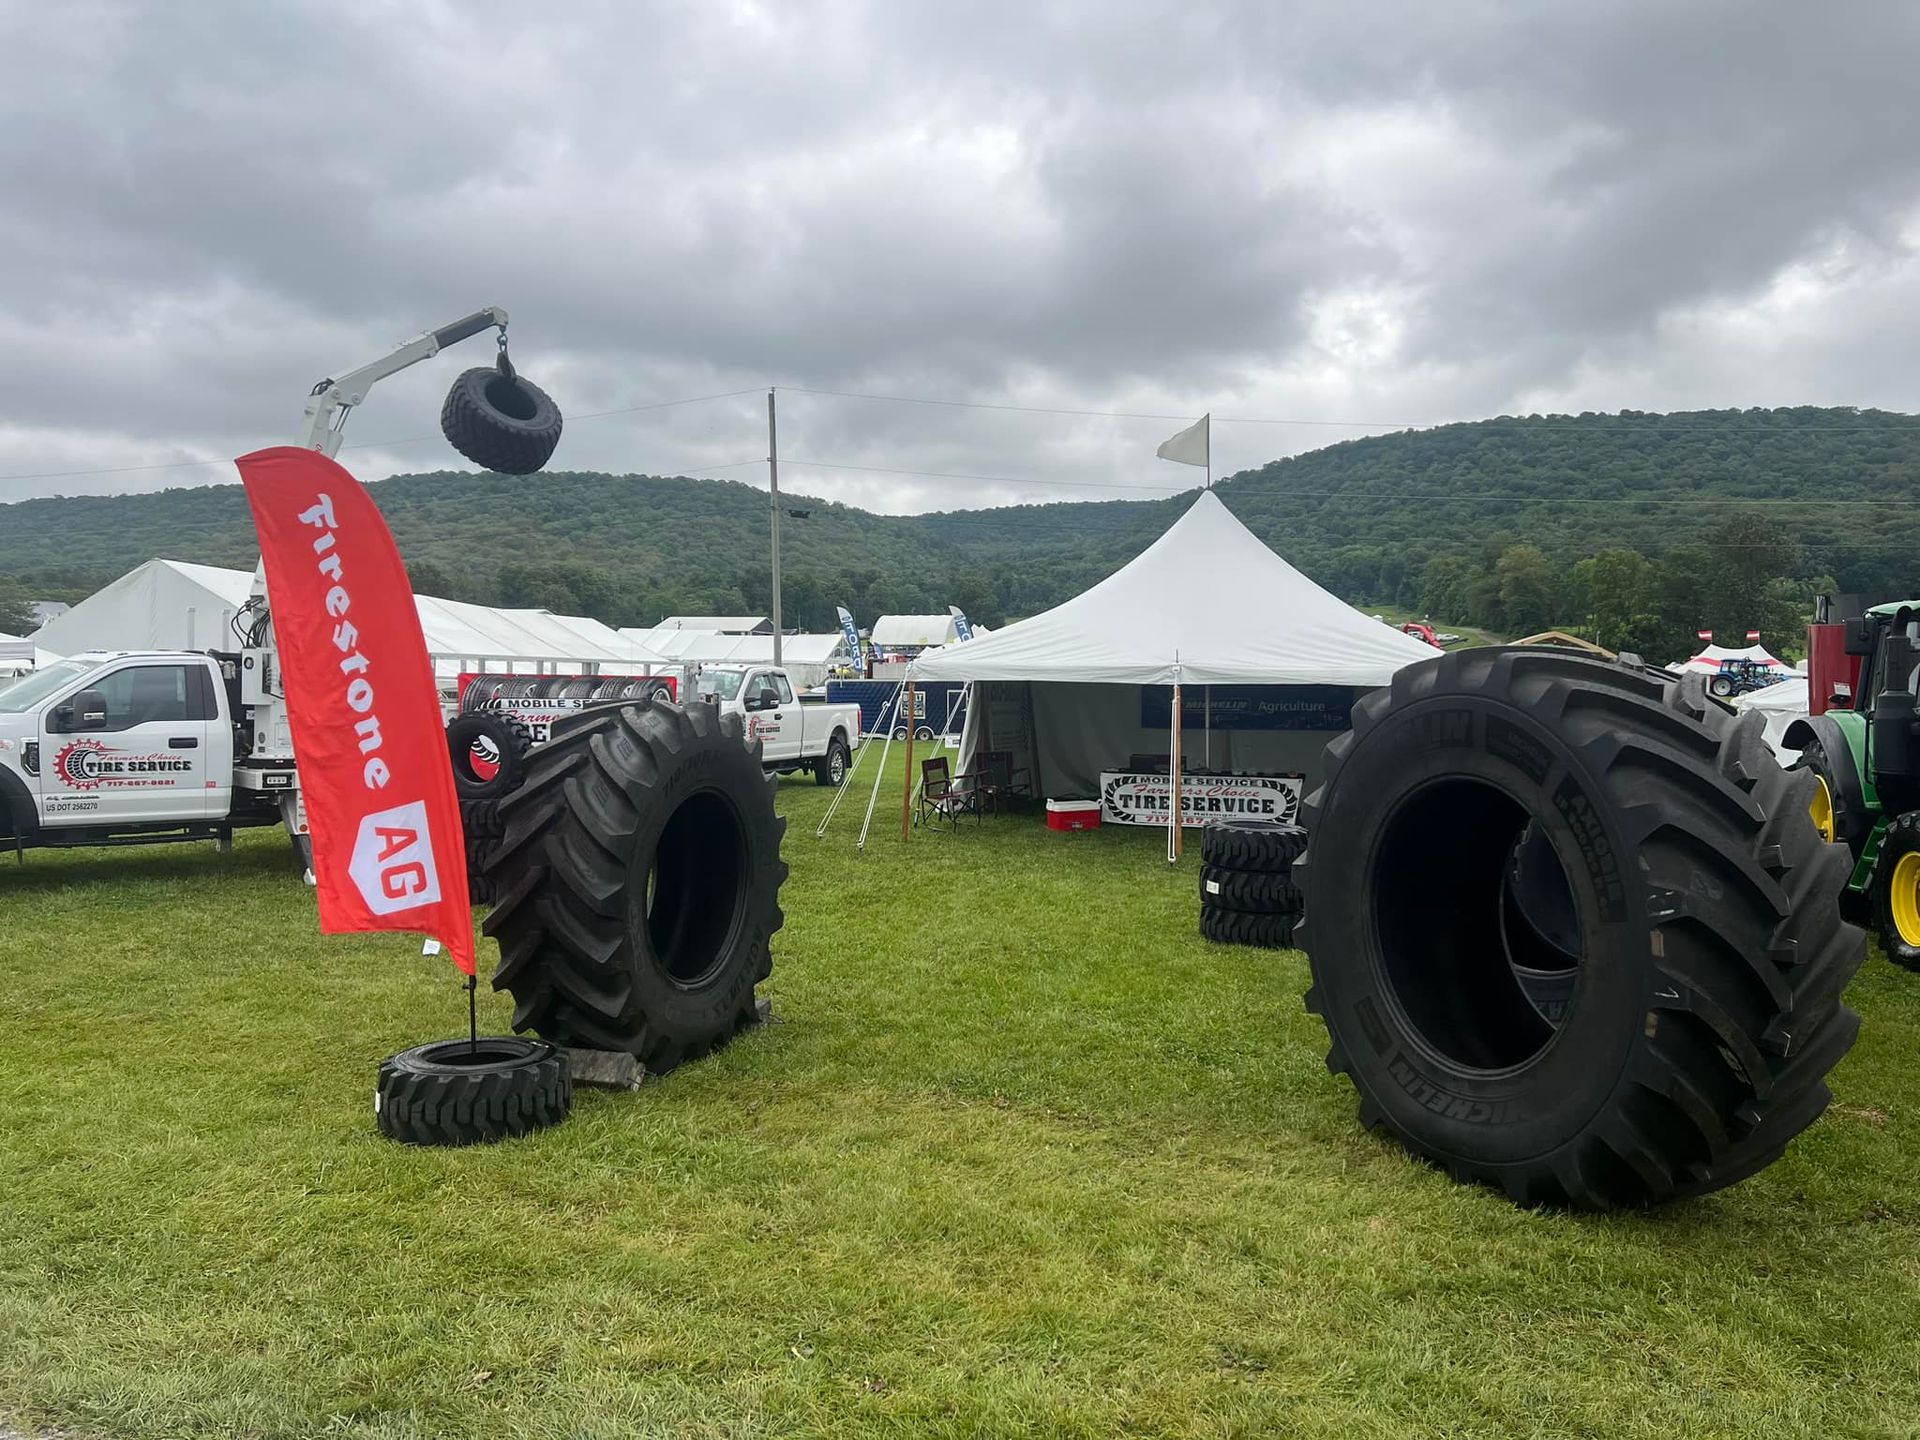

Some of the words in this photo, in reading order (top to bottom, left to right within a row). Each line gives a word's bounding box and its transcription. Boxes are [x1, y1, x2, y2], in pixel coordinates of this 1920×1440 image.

[298, 493, 391, 790] Firestone
[508, 699, 567, 709] MOBILE
[1257, 700, 1326, 713] Agriculture
[86, 761, 123, 773] TIRE
[128, 760, 192, 772] SERVICE
[1140, 776, 1191, 785] MOBE
[1196, 778, 1259, 787] SERVICE
[1206, 785, 1261, 797] Choice
[46, 804, 56, 812] US
[57, 803, 71, 811] DOT
[1118, 794, 1170, 810] TIRE
[1180, 796, 1275, 814] SERVICE
[374, 825, 428, 900] AG
